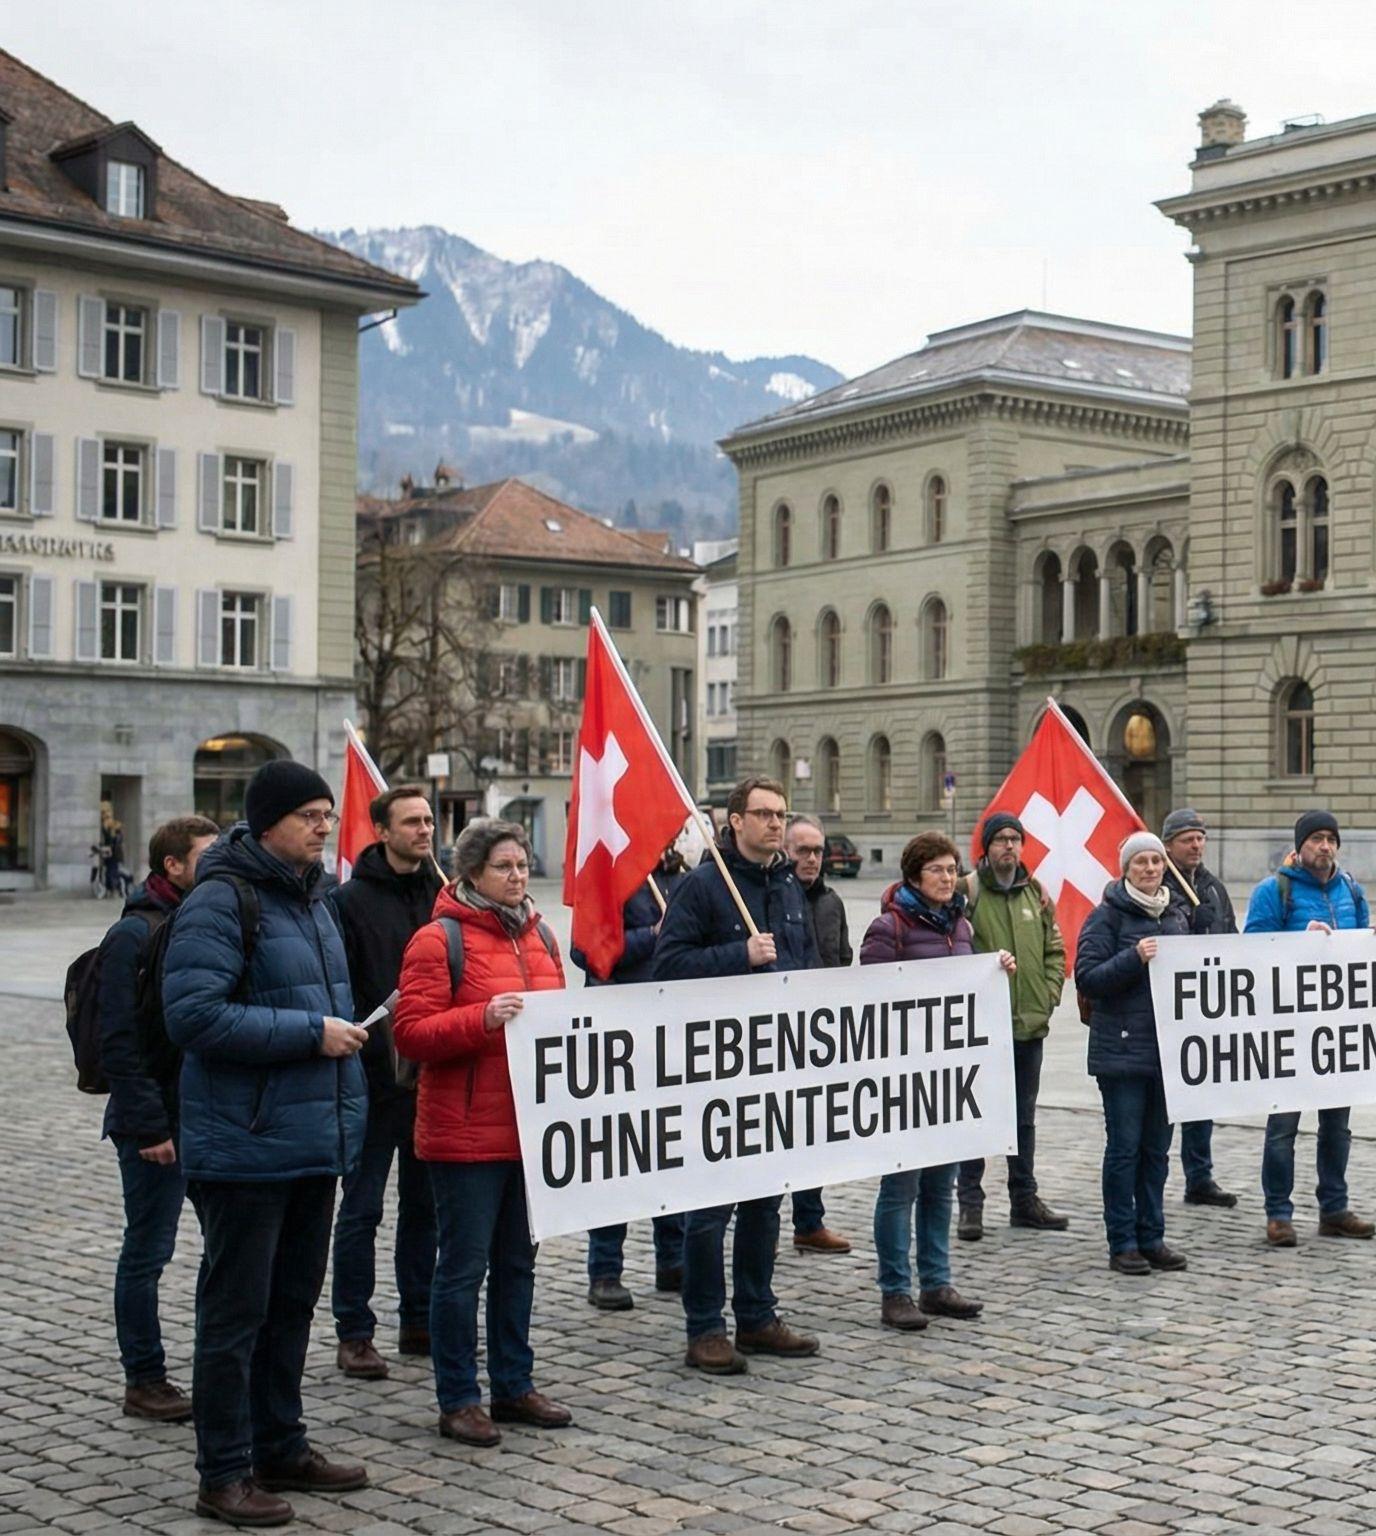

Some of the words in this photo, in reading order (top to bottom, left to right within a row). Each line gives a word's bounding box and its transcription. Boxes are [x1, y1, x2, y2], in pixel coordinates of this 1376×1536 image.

[1174, 956, 1256, 1020] FÜR
[535, 1017, 635, 1104] FÜR
[656, 992, 989, 1088] LEBENSMITTEL
[1180, 1029, 1296, 1086] OHNE
[542, 1104, 684, 1189] OHNE
[702, 1064, 982, 1163] GENTECHNIK
